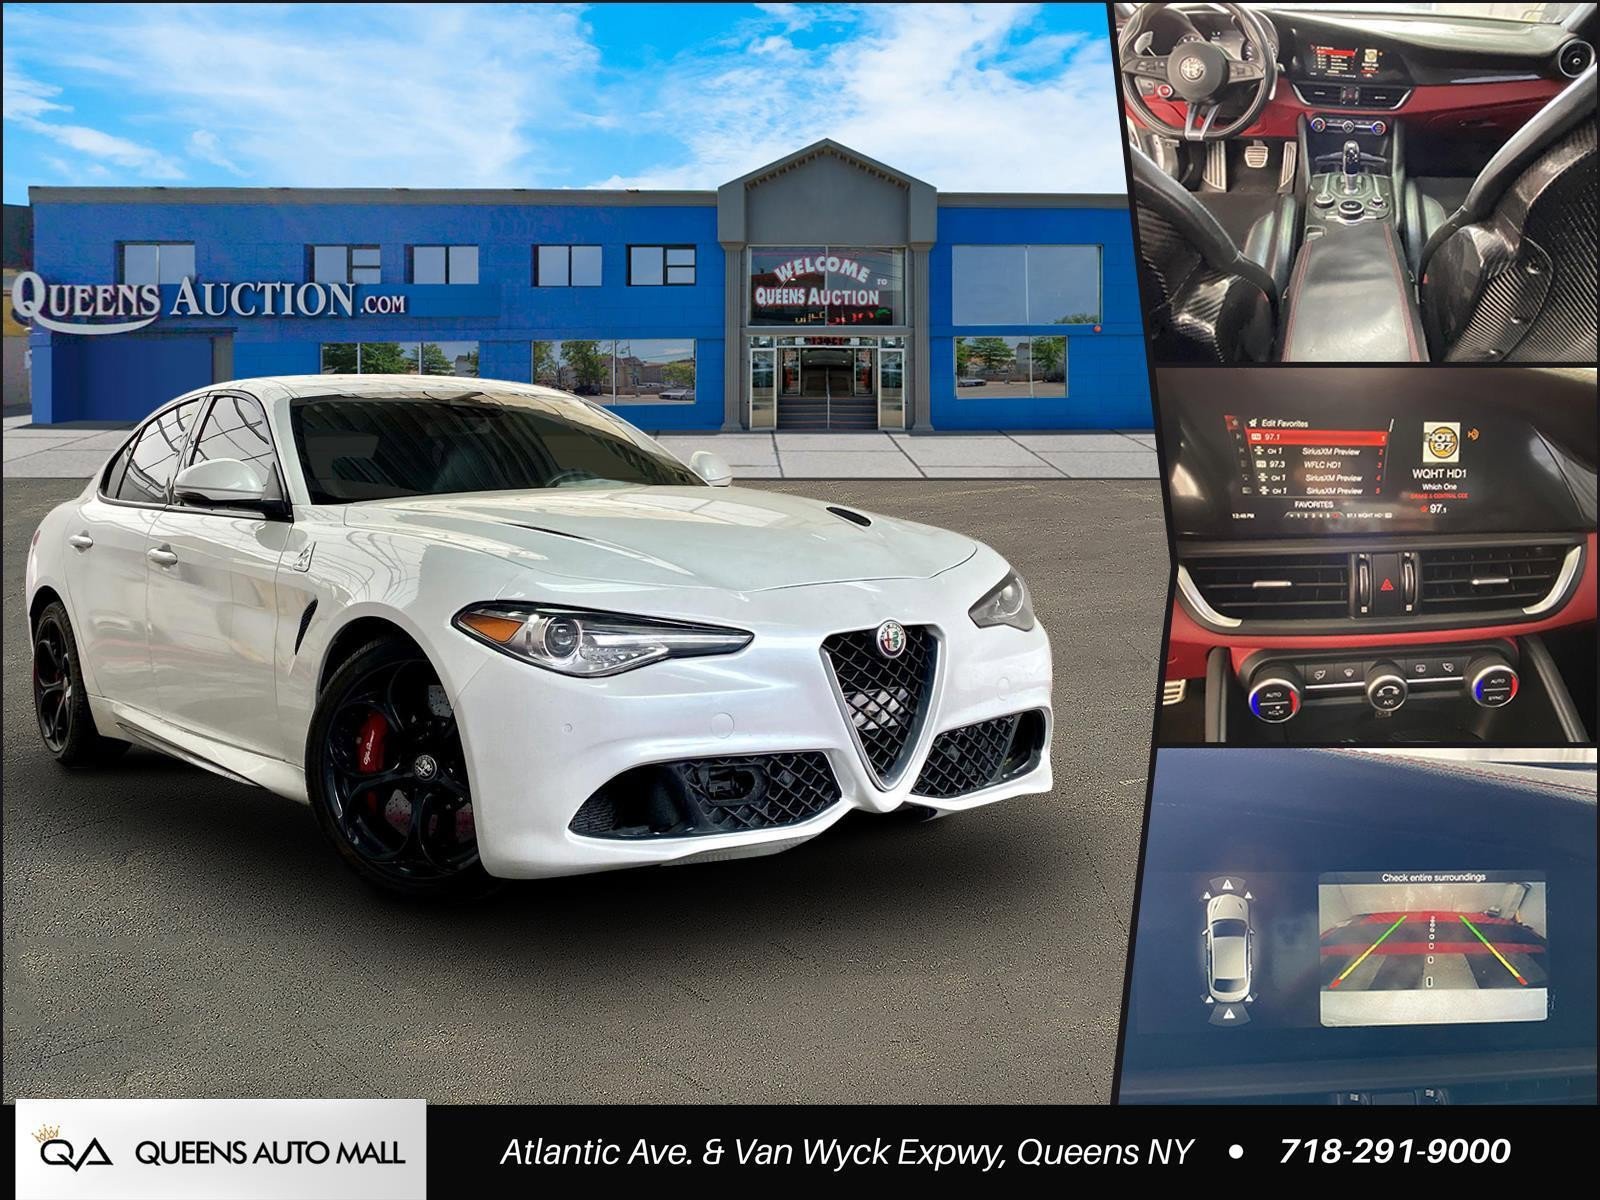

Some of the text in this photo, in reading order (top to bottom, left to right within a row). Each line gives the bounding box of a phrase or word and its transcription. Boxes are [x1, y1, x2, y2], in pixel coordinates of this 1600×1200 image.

[774, 256, 870, 284] WELCOME
[755, 287, 879, 306] QUEENS AUCTION
[12, 271, 405, 335] QUEENS AUCTION .COM
[1261, 419, 1309, 429] Edit Favorites
[1265, 433, 1280, 441] 97.1
[1302, 447, 1333, 456] SiriusXM
[1334, 448, 1361, 456] Preview
[1305, 473, 1336, 482] SiriusXM
[1337, 474, 1363, 482] Preview
[1412, 468, 1467, 479] WQHT HD1
[1306, 486, 1336, 495] SiriusXM
[1337, 487, 1363, 495] Preview
[1422, 482, 1457, 490] Which One
[1294, 500, 1334, 509] FAVORITES
[1382, 872, 1486, 883] Check entire surroundings
